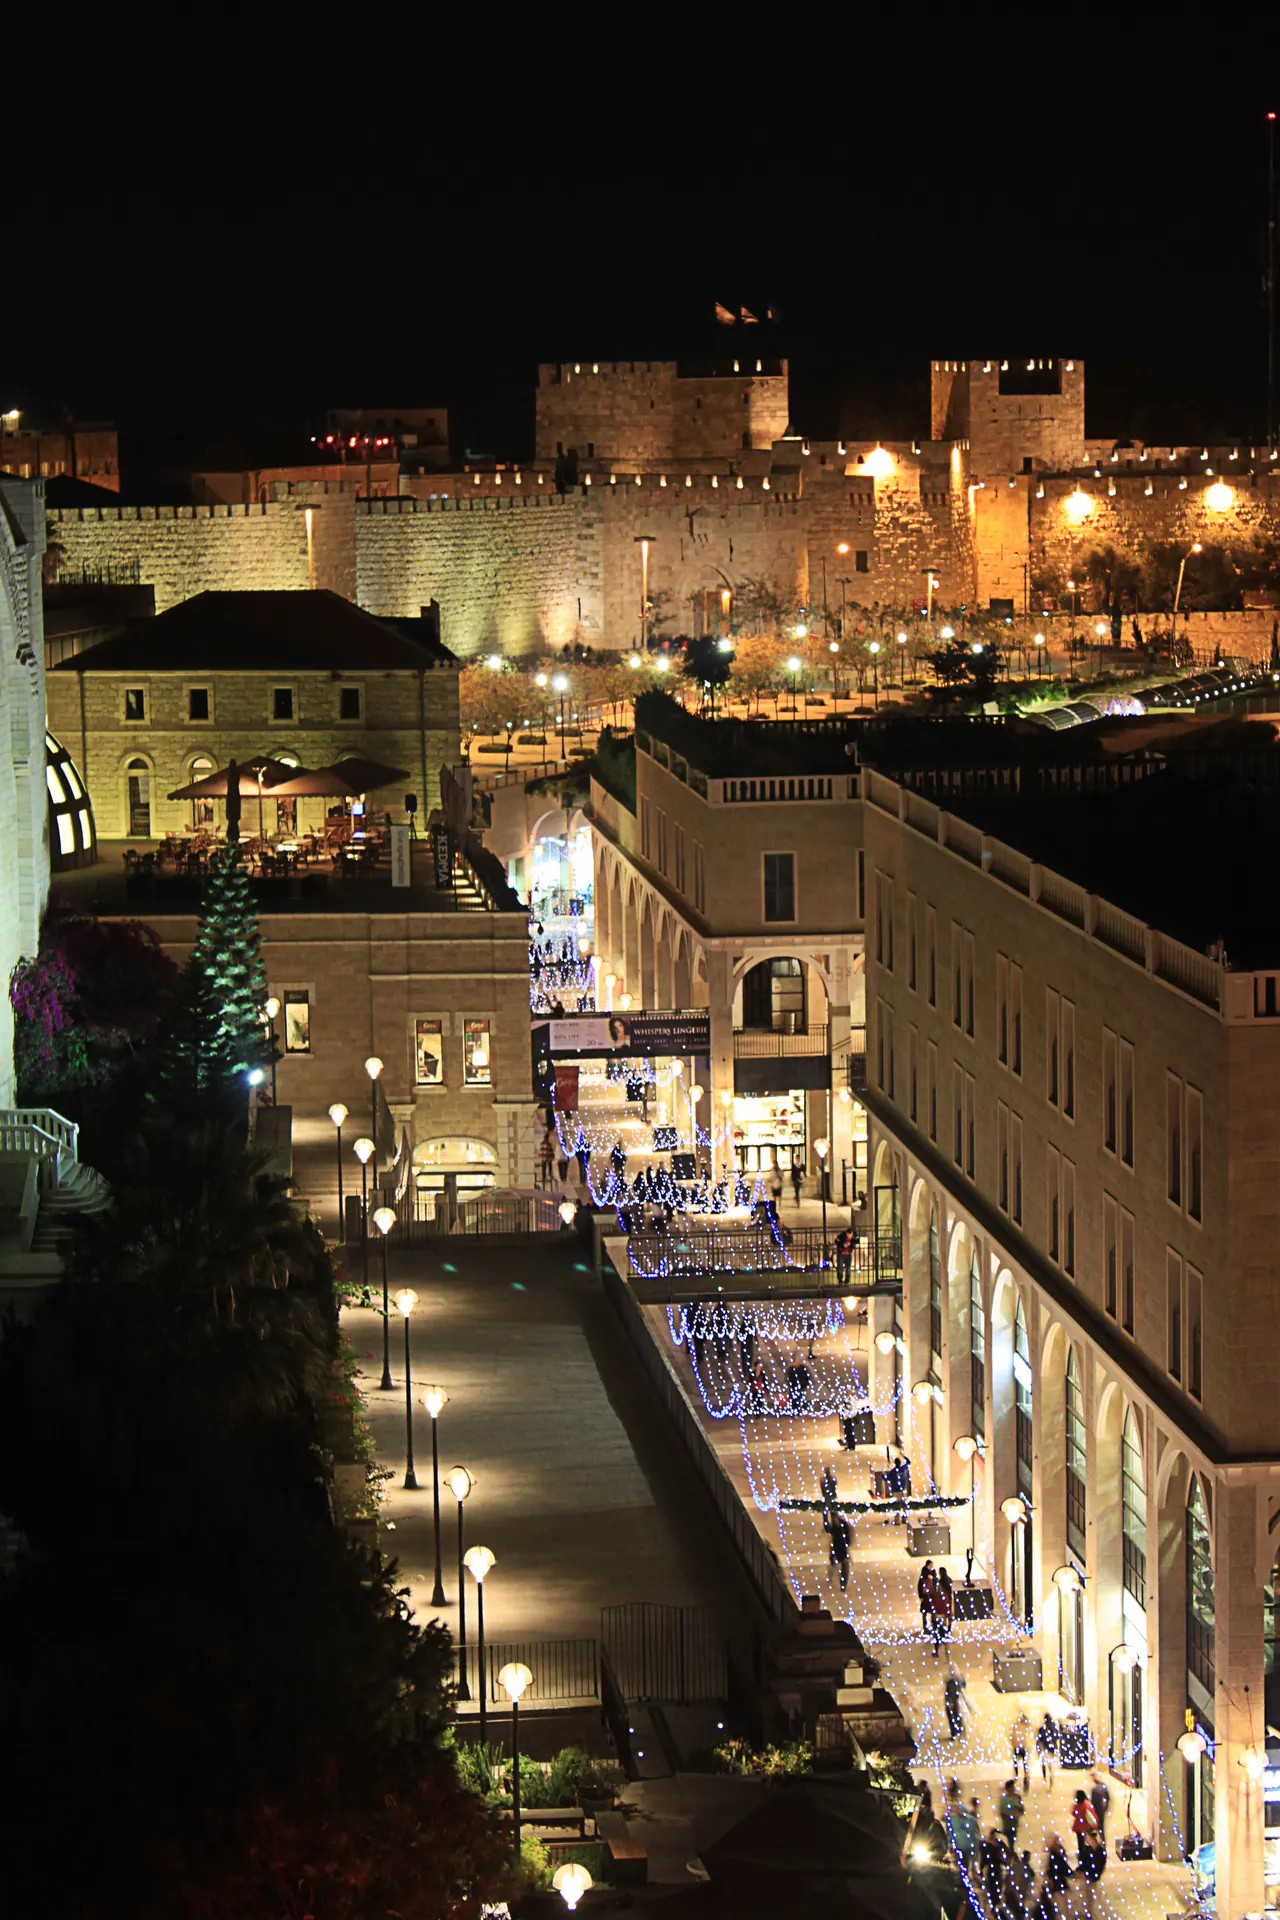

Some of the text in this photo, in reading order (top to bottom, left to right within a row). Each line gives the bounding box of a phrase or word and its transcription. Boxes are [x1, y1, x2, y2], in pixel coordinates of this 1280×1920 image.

[437, 834, 449, 882] KEDMA
[633, 1026, 707, 1036] WHISPERS LINGERIE
